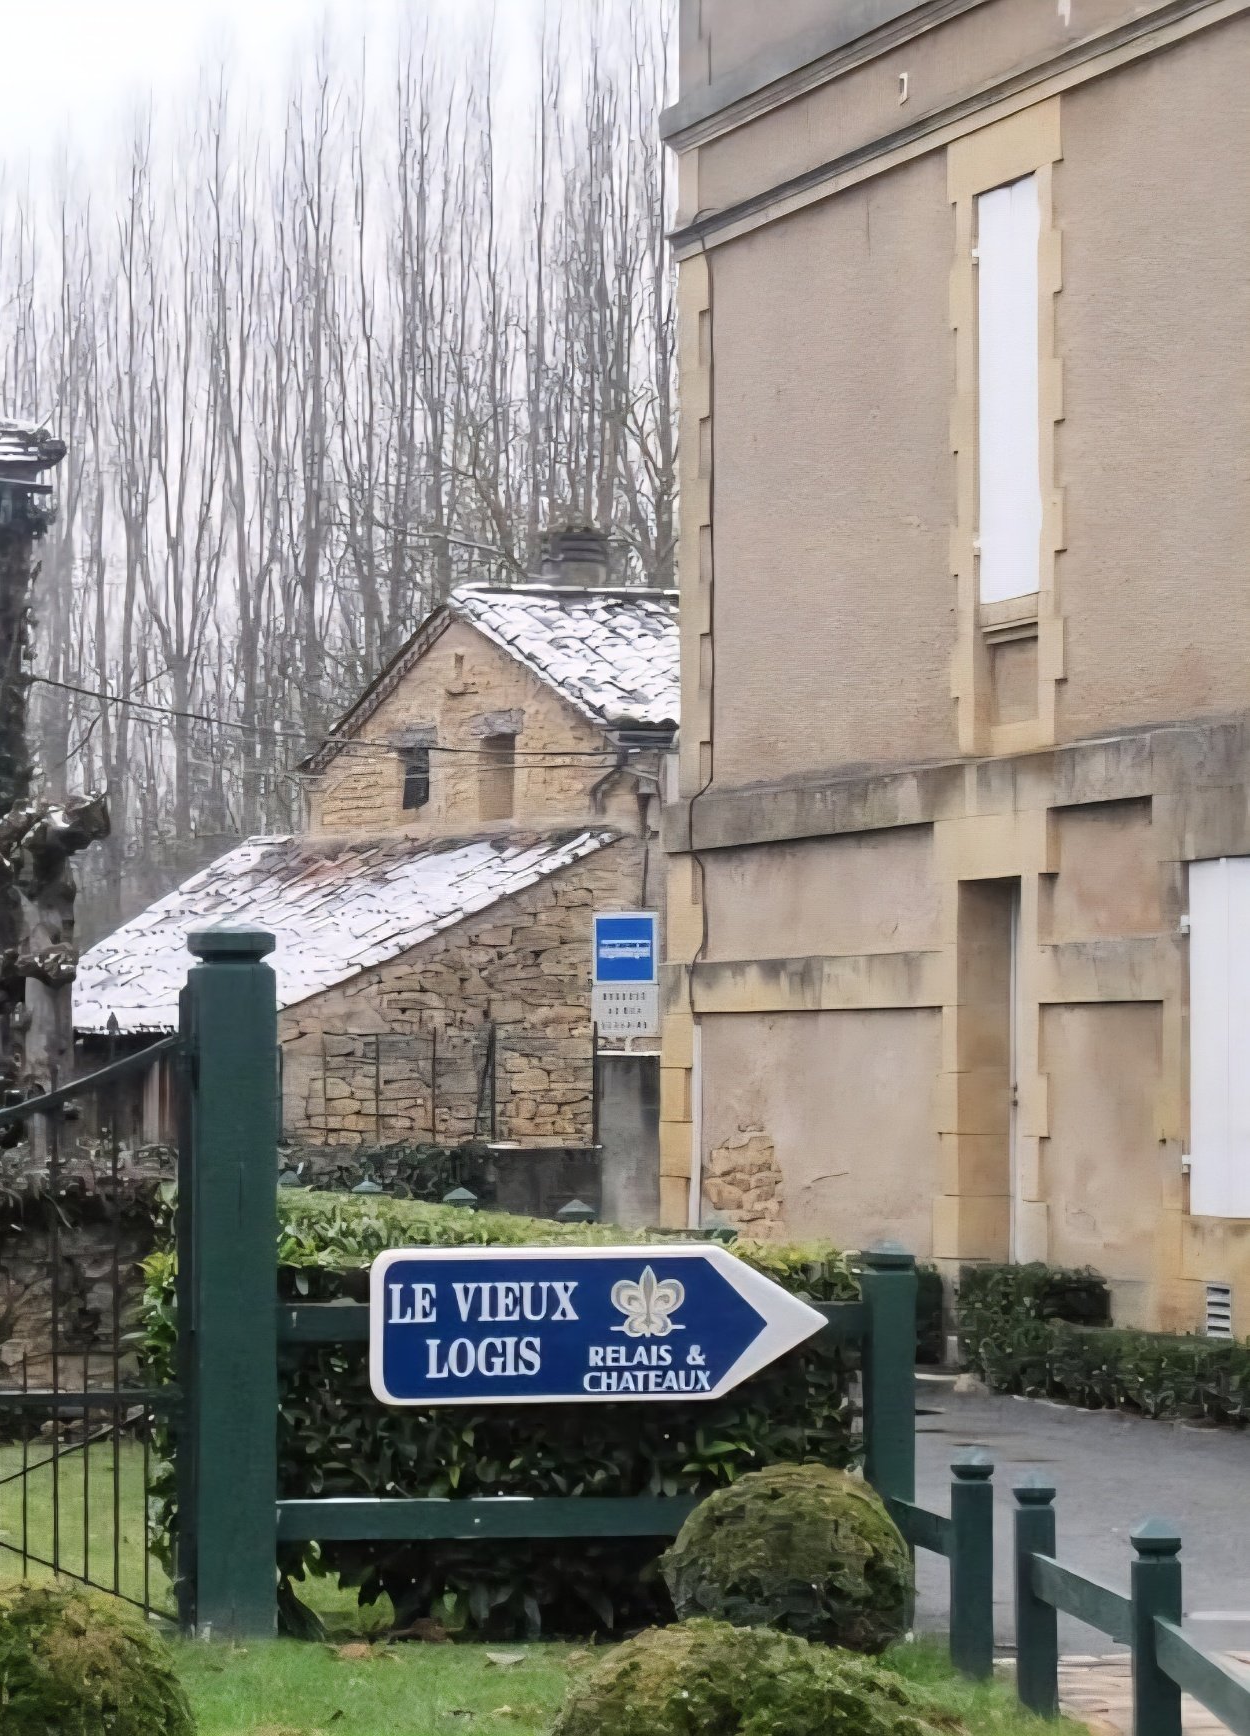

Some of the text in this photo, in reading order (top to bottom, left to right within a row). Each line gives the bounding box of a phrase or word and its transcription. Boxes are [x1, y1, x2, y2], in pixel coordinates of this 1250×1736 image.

[388, 1281, 579, 1323] LE VIEUX
[425, 1336, 541, 1378] LOGIS
[588, 1344, 706, 1367] RELAIS &
[583, 1370, 711, 1392] CHATEAUX
